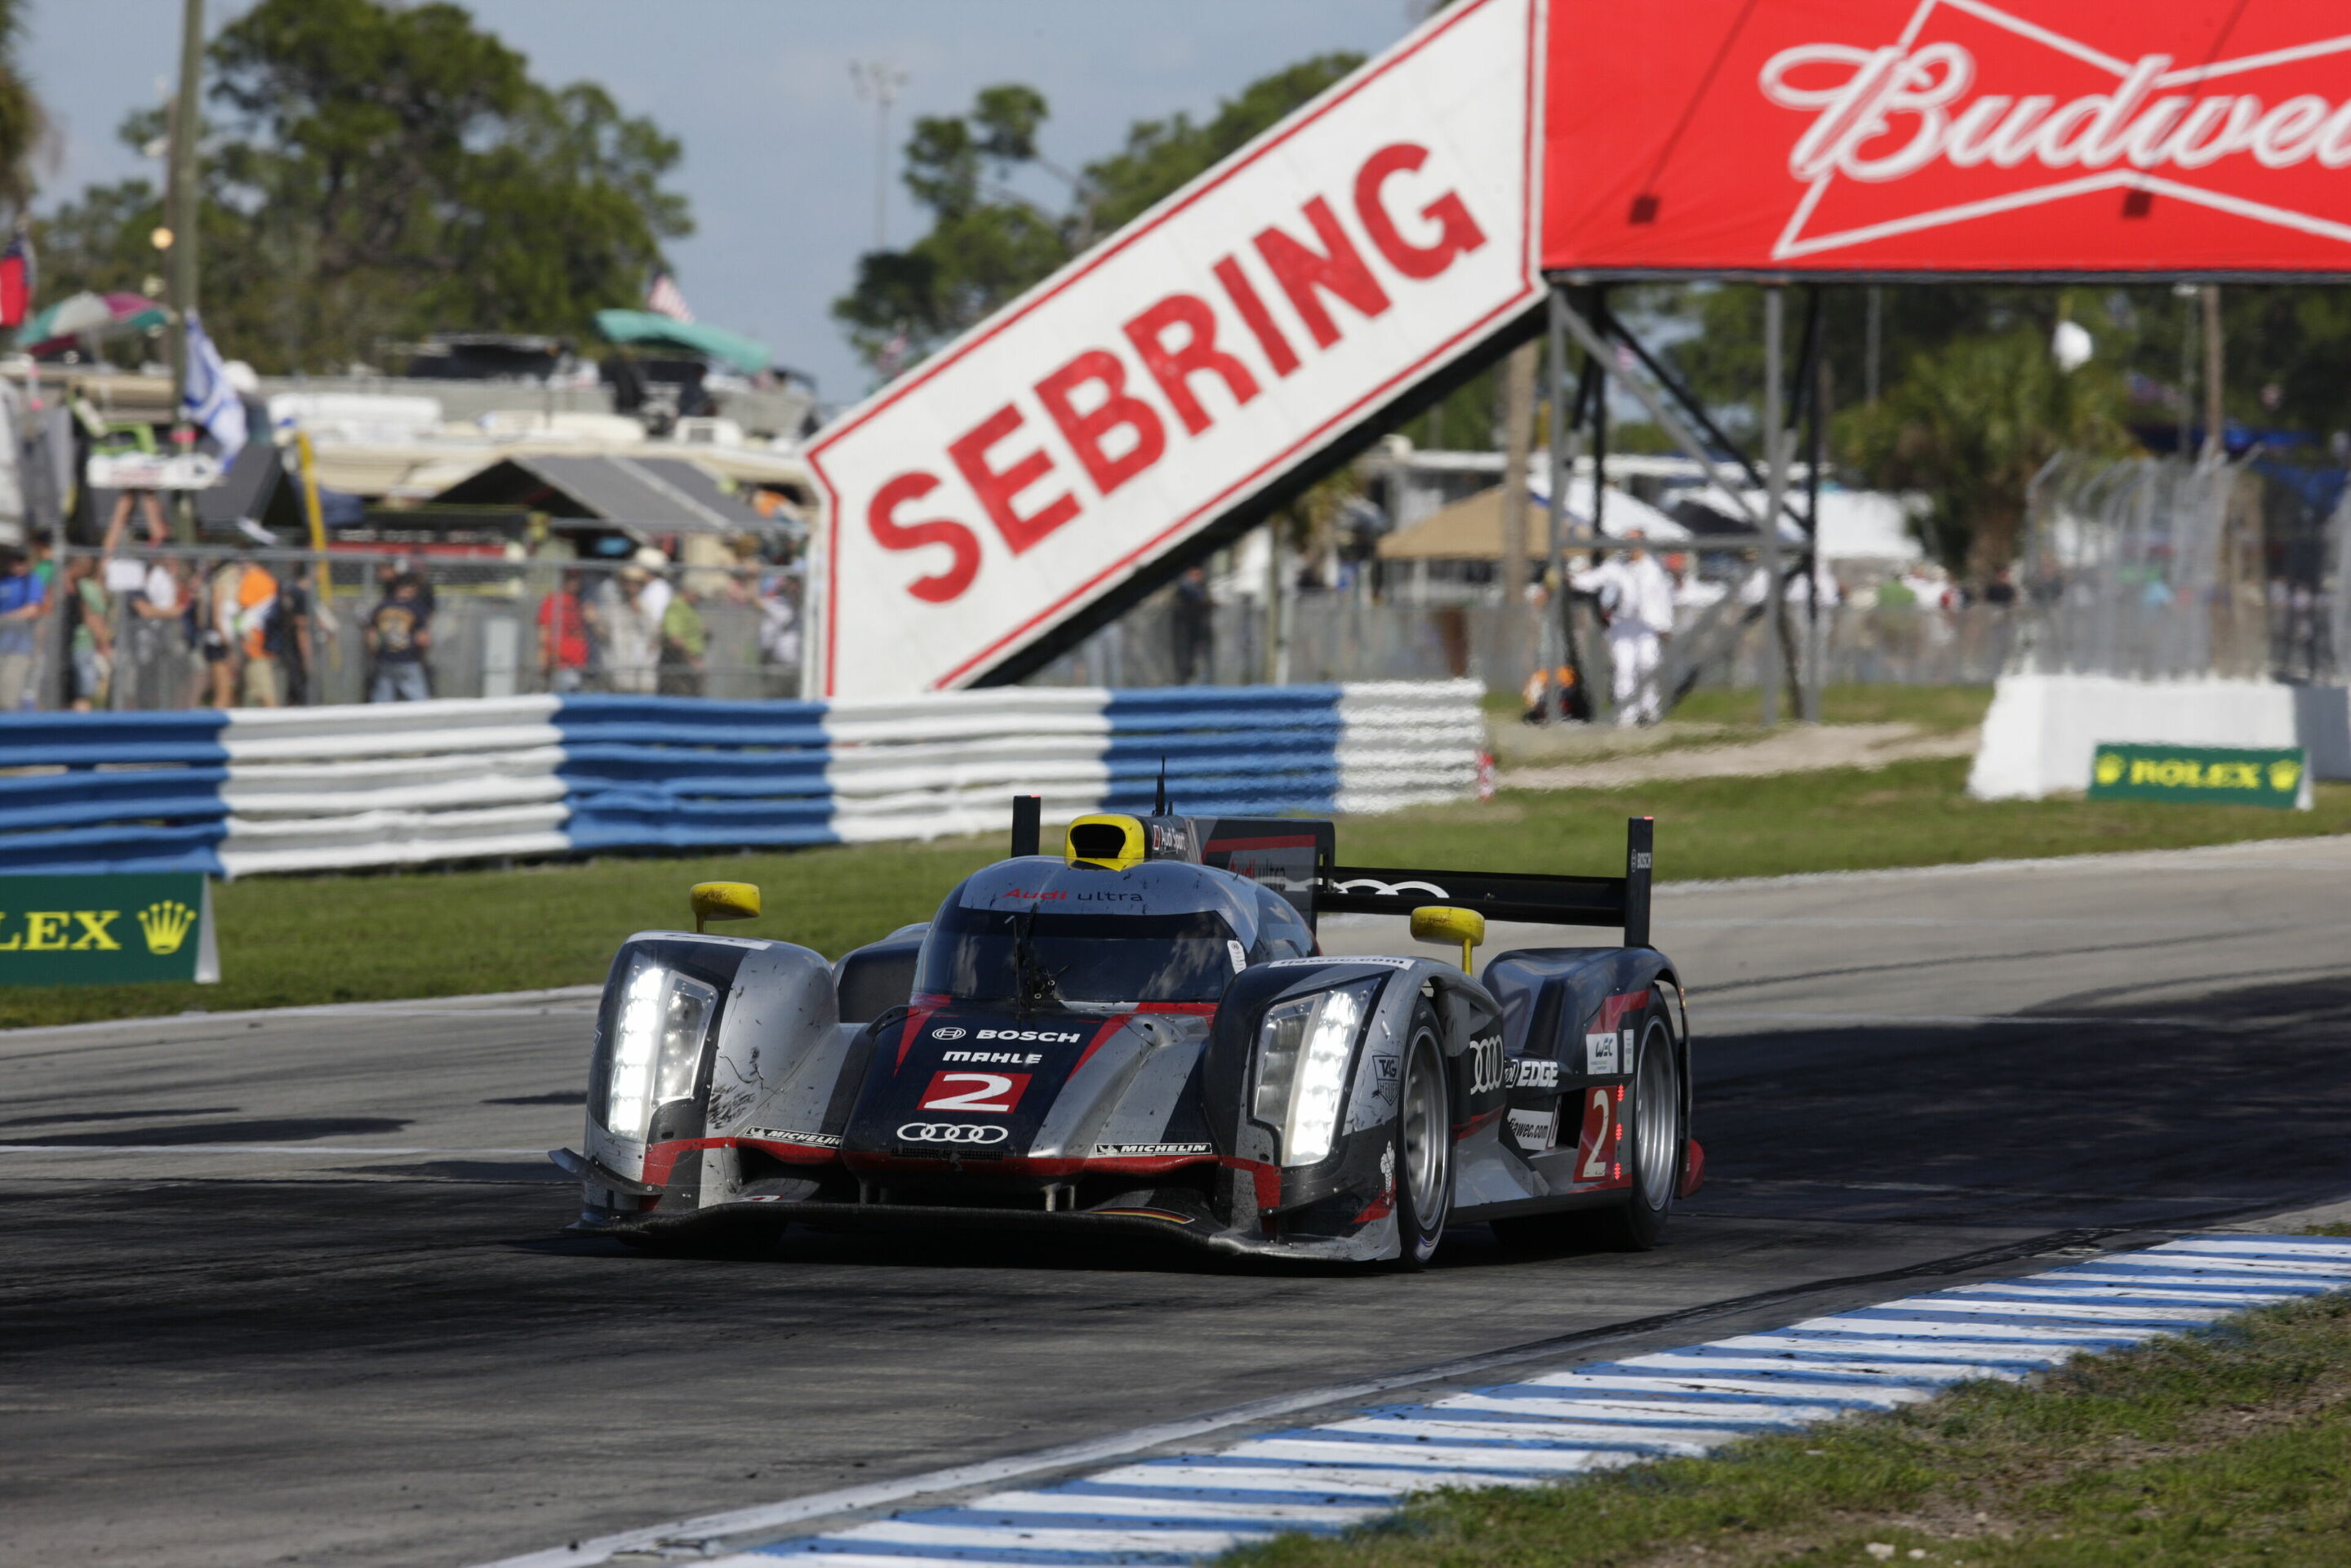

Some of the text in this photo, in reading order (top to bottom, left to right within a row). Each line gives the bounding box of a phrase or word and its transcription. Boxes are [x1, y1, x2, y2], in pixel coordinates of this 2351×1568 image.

[867, 141, 1487, 604] SEBRING
[2129, 758, 2262, 789] ROLEX
[1002, 888, 1144, 902] Audi ultra
[976, 1029, 1082, 1043] BOSCH
[942, 1051, 1043, 1064] MAHLE
[1378, 1059, 1398, 1077] TAG
[1516, 1060, 1559, 1088] EDGE
[923, 1073, 1013, 1113] 2
[767, 1130, 842, 1145] MICHELIN
[1582, 1089, 1610, 1178] 2
[1120, 1144, 1207, 1153] MICHELIN
